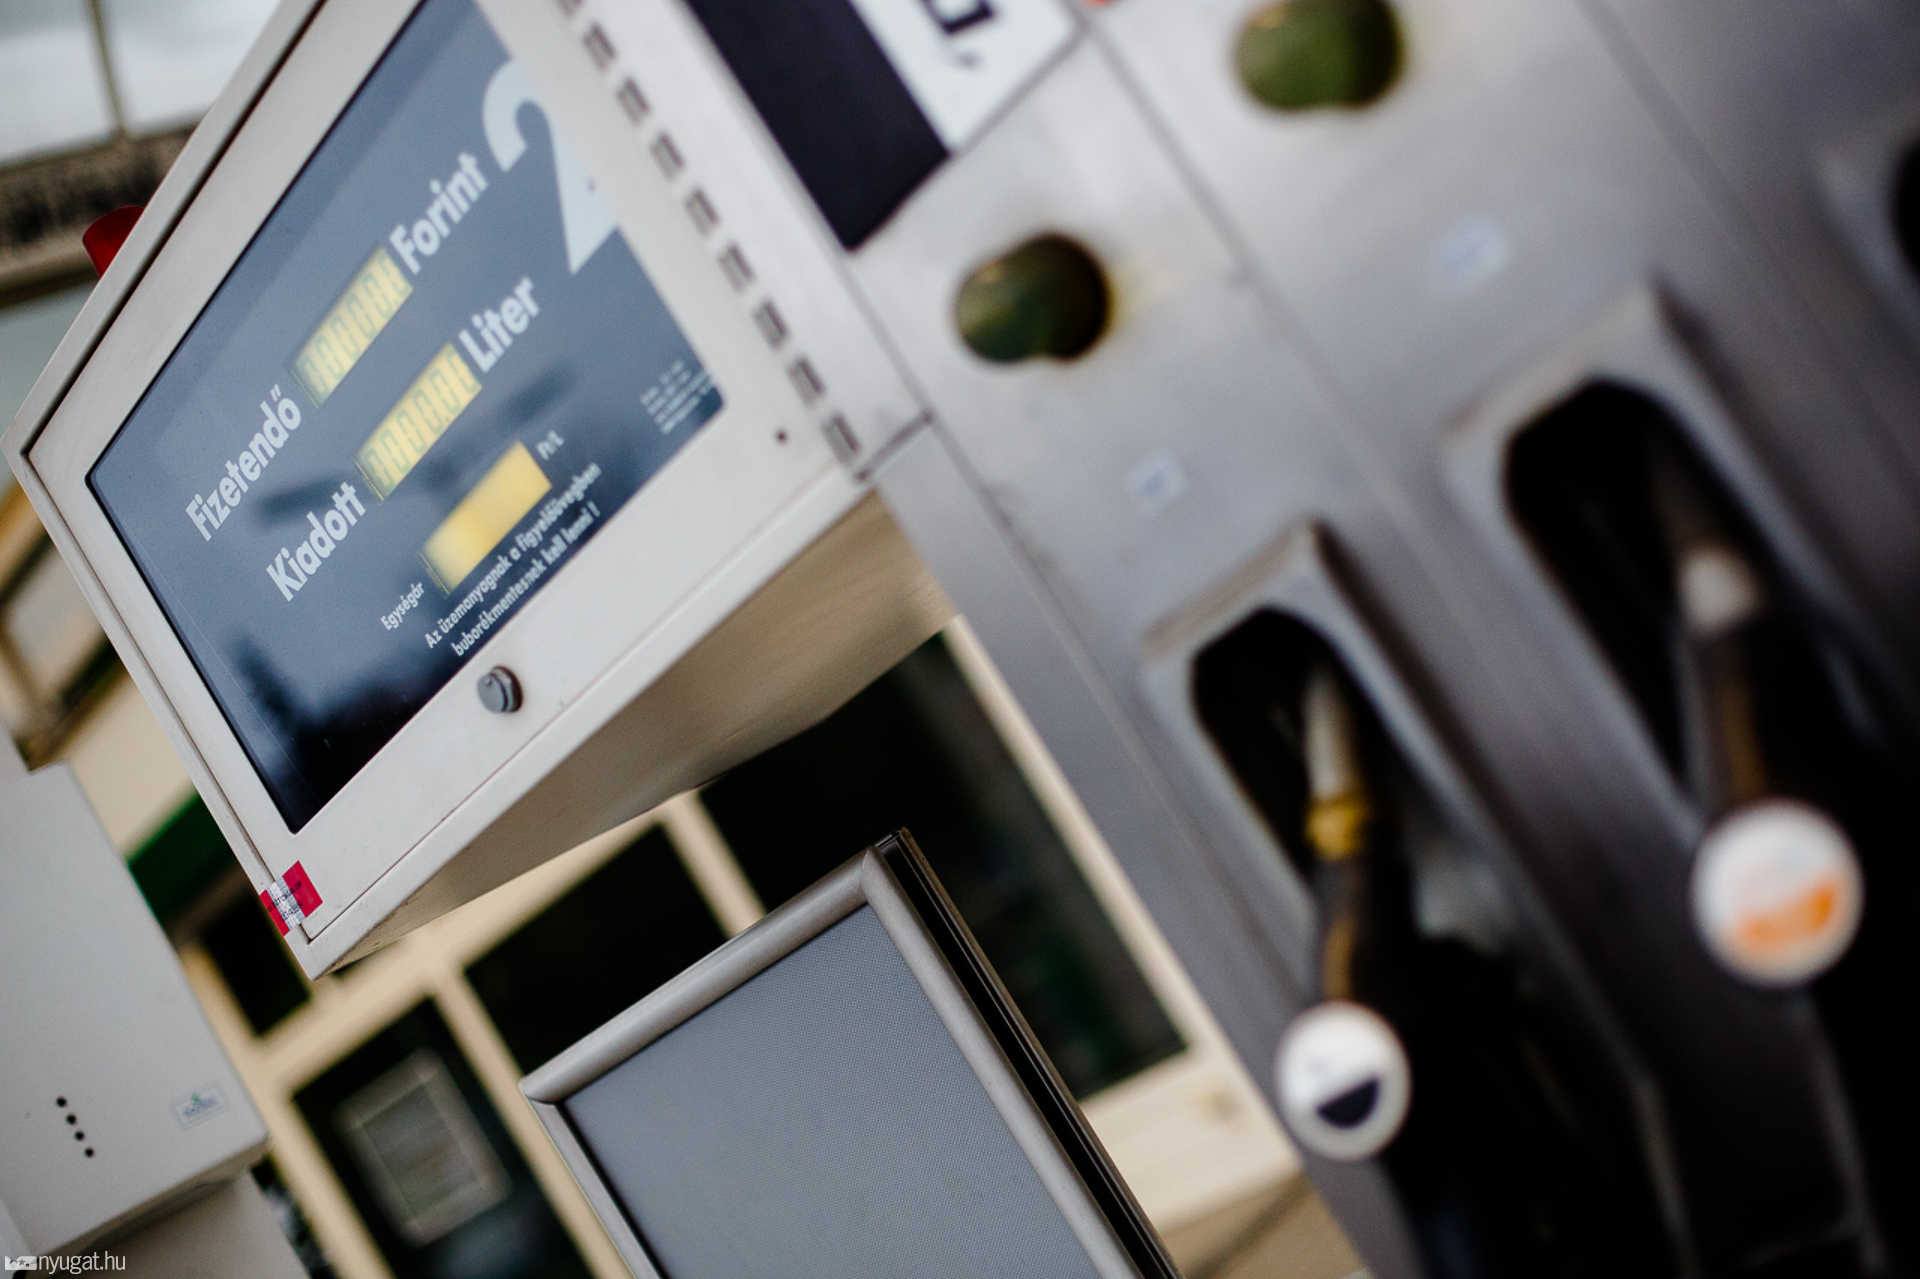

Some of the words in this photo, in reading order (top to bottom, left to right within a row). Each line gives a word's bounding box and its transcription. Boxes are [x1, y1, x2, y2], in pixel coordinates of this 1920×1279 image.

[483, 57, 620, 275] 2
[184, 384, 302, 541] Fizetendő
[390, 151, 489, 274] Forint
[265, 480, 368, 602] Kiadott
[459, 277, 541, 372] Liter
[380, 580, 425, 632] Egységár
[424, 629, 443, 649] Az
[437, 554, 513, 634] üzemanyagnak
[509, 546, 521, 561] a
[451, 557, 547, 657] buborékmentesnek
[541, 534, 567, 565] kell
